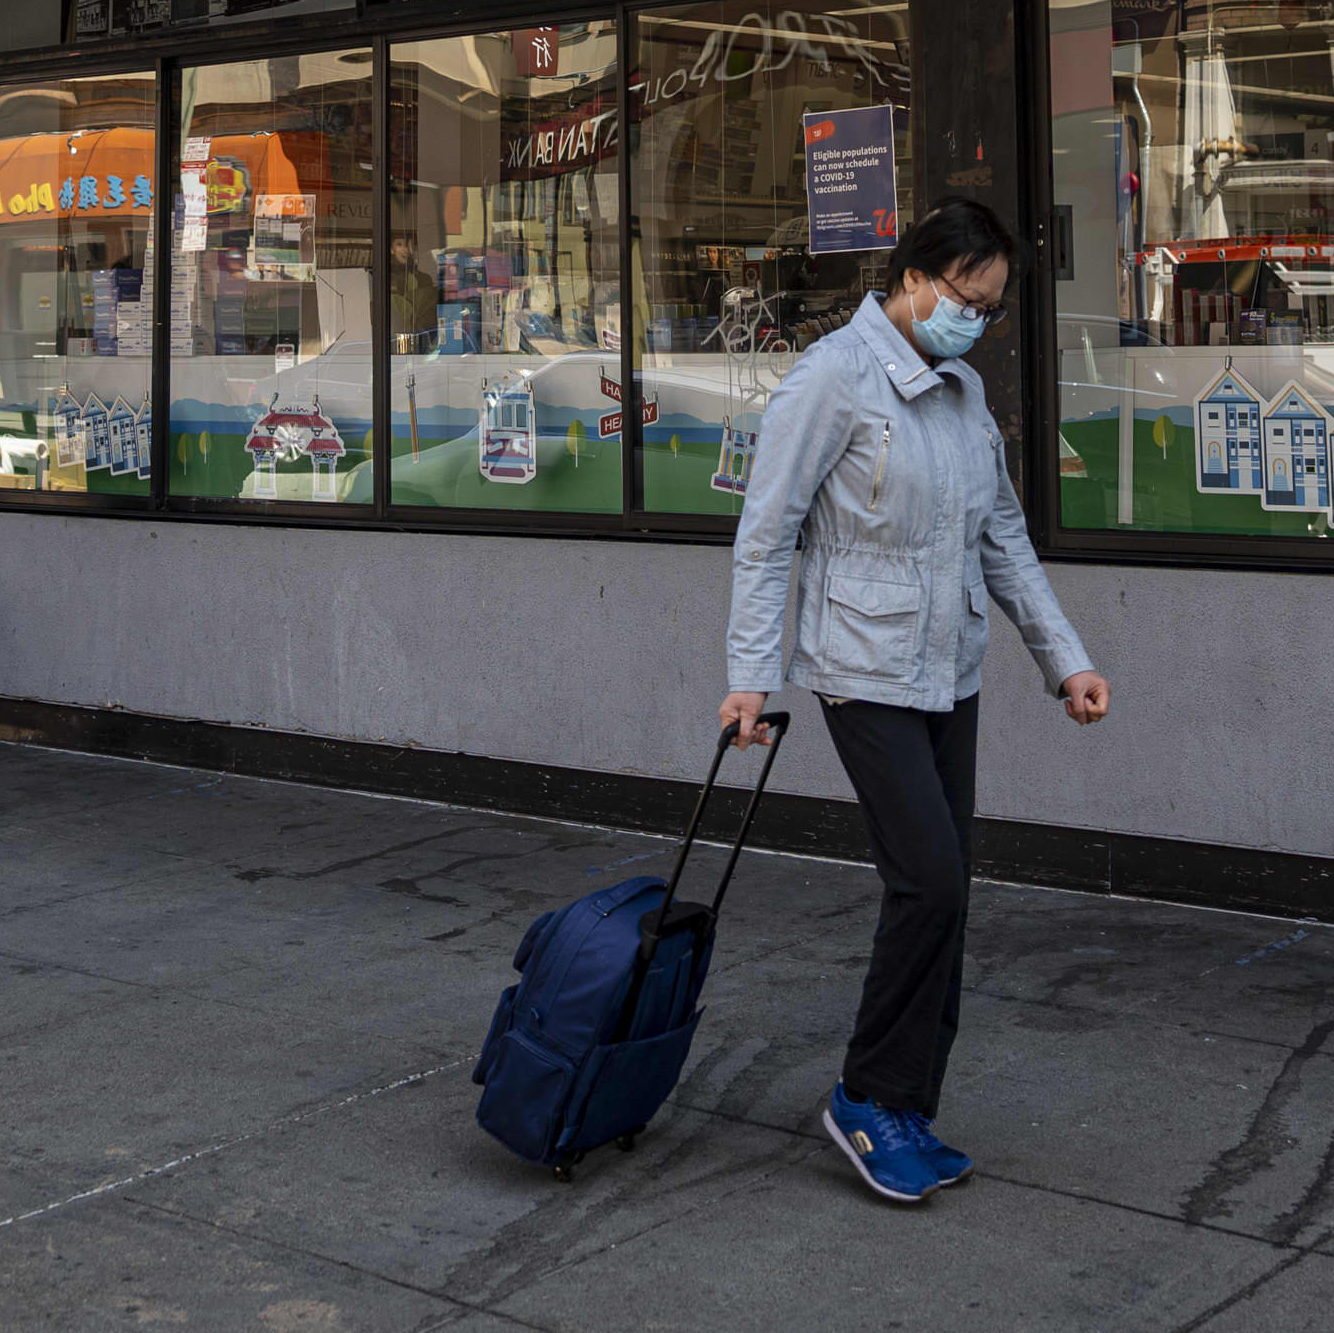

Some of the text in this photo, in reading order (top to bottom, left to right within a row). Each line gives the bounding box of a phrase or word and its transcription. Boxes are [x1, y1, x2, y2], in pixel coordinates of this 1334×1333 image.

[813, 146, 887, 162] Eligible populations
[1311, 142, 1318, 154] 4
[814, 157, 879, 172] can now schedule
[820, 171, 855, 182] COVID-19
[814, 182, 858, 195] vaccination
